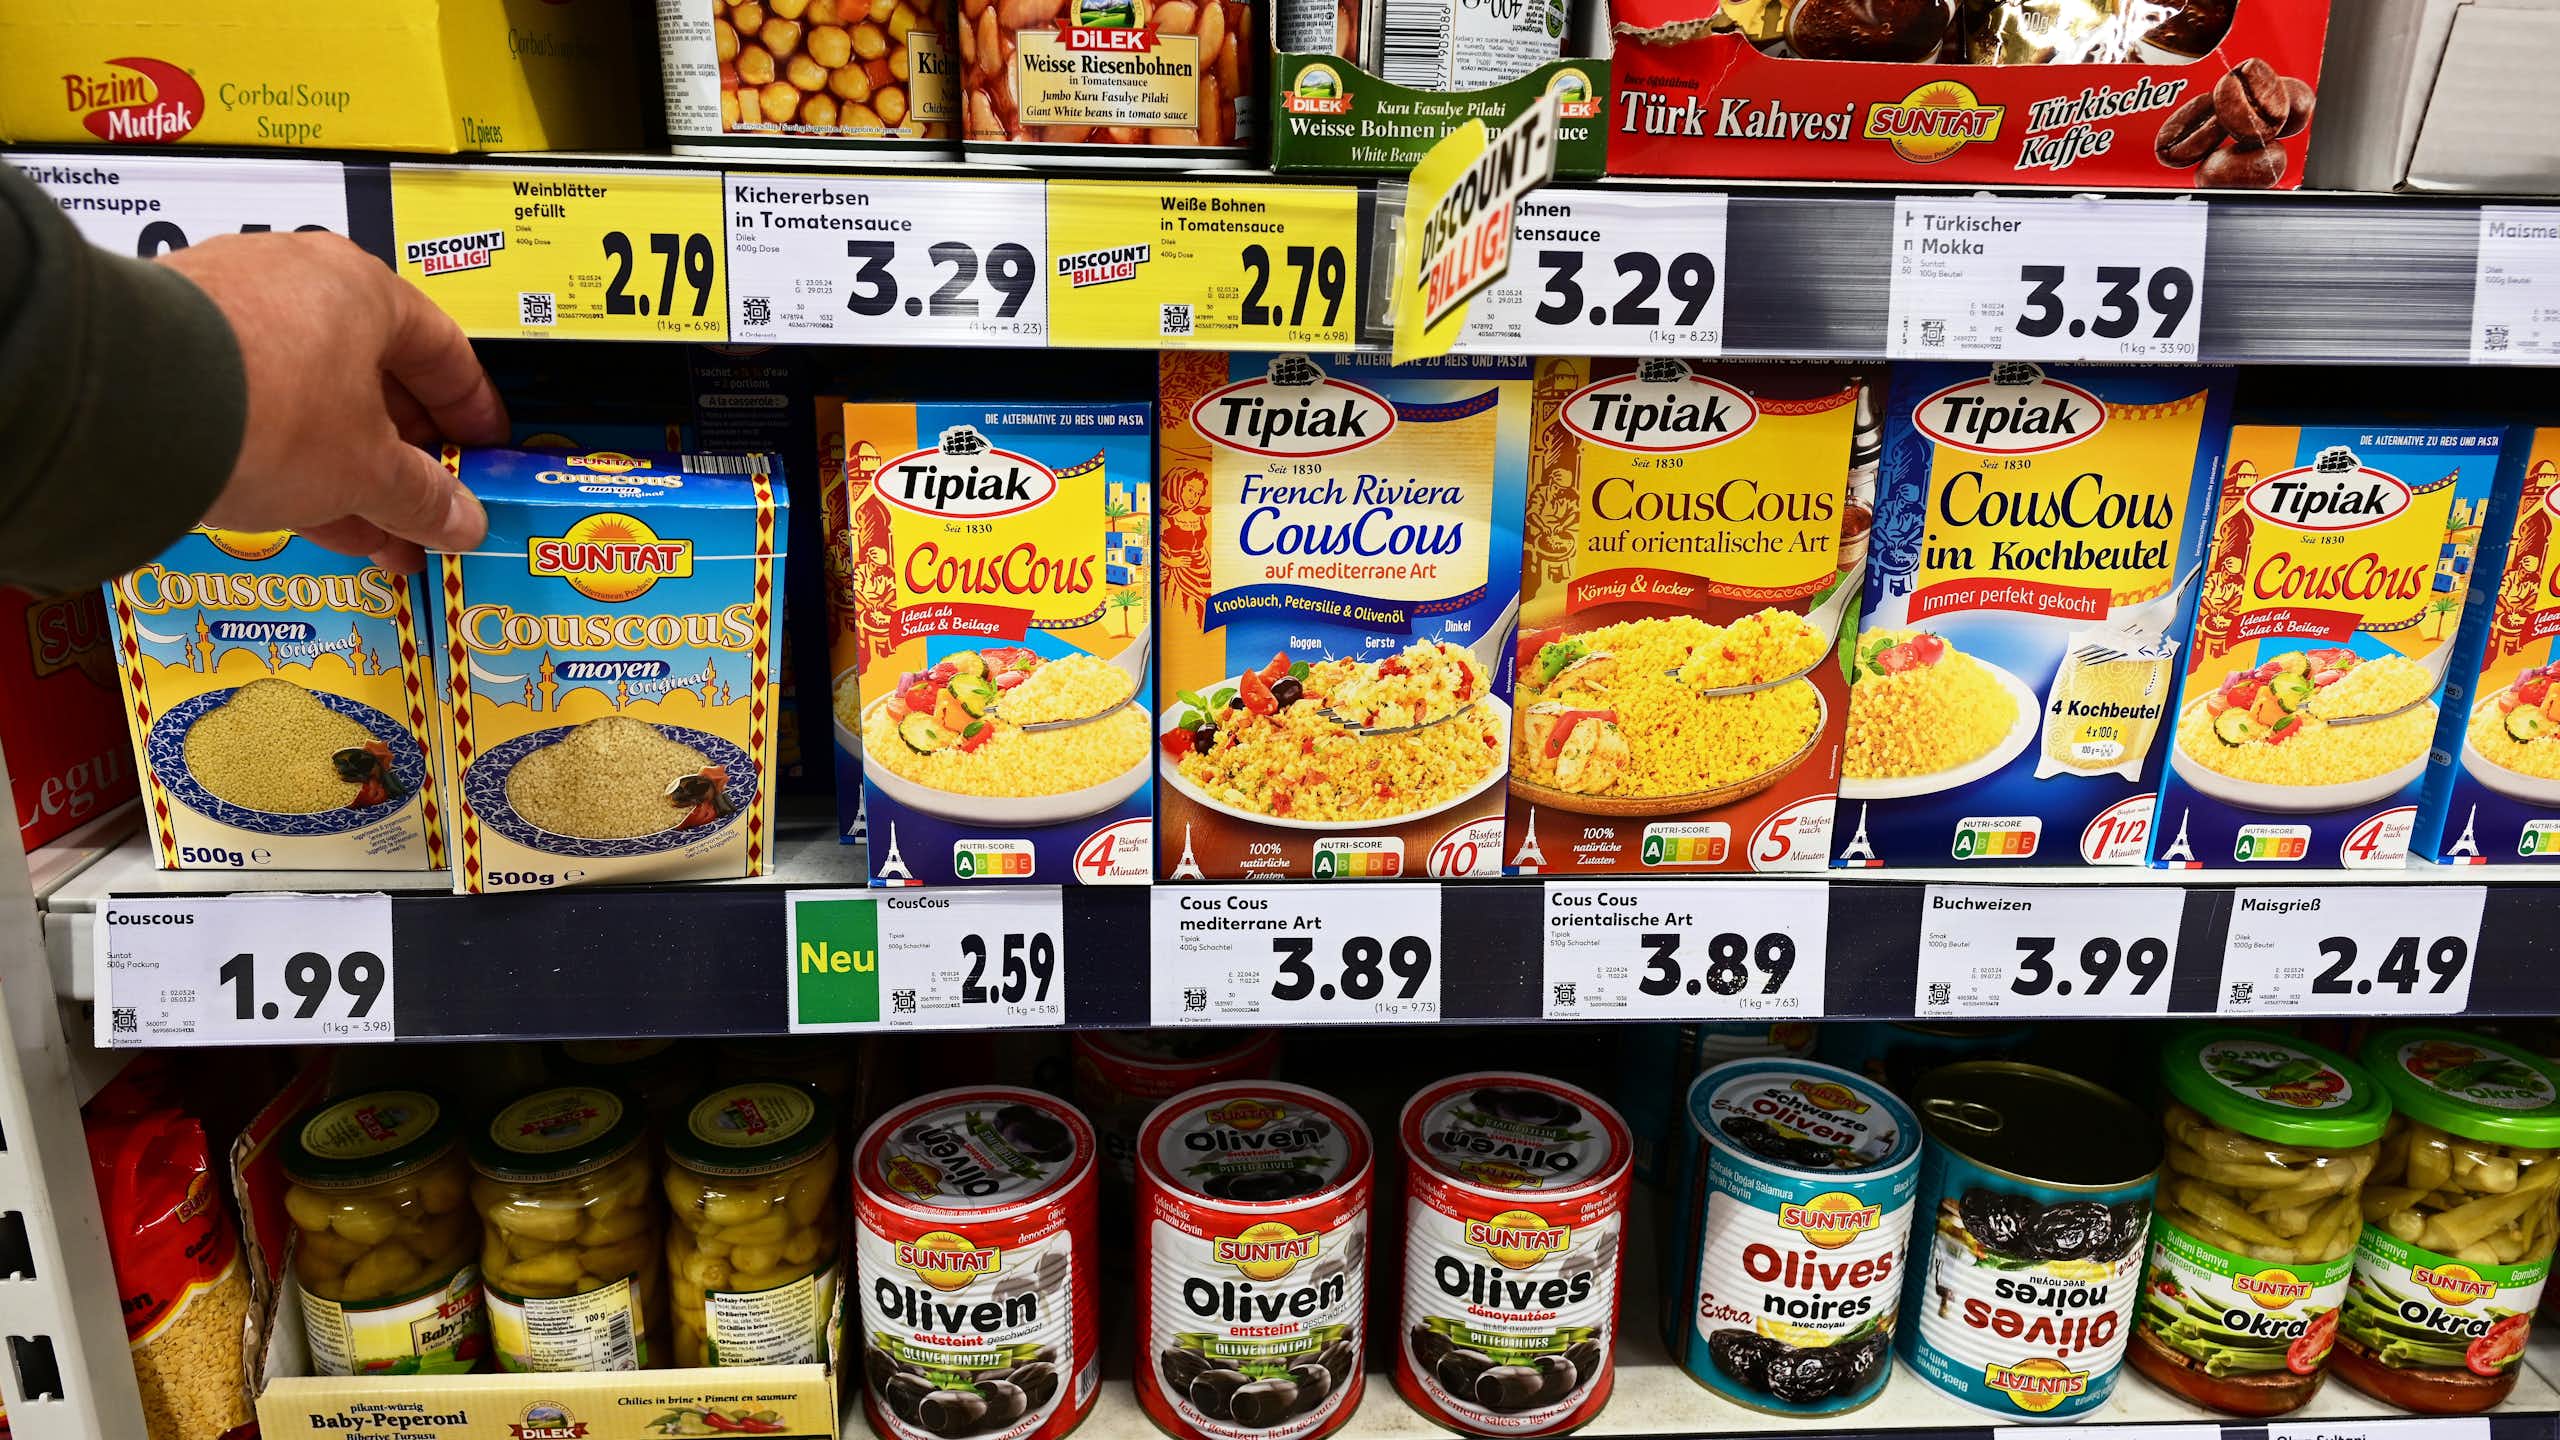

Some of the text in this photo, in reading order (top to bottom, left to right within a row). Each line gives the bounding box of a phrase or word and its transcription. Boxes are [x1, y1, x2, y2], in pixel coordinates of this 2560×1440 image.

[1024, 54, 1193, 77] Weisse Riesenbohnen
[62, 74, 147, 111] Bizim
[1041, 90, 1169, 104] Jumbo Kuru Fasulye Pilaki
[2029, 76, 2189, 134] Türkischer
[108, 103, 193, 140] Mutfak
[1027, 106, 1188, 120] Giant White beans in tomato sauce
[1377, 101, 1505, 117] Kuru Fasulye Pilaki
[1619, 90, 1856, 142] Türk Kahvesi
[1871, 106, 1998, 138] SUNTAT
[257, 116, 323, 144] Suppe
[463, 115, 502, 145] 12 pieces
[2014, 127, 2115, 170] Kaffee
[513, 181, 607, 199] Weinblätter
[735, 186, 869, 206] Kichererbsen
[514, 203, 566, 220] gefüllt
[1160, 197, 1265, 213] Weiße Bohnen
[736, 212, 912, 231] in Tomatensauce
[1160, 217, 1285, 234] in Tomatensauce
[1923, 214, 2022, 233] Türkischer
[407, 232, 501, 262] DISCOUNT
[1058, 245, 1147, 273] DISCOUNT
[1426, 201, 1511, 318] BILLIG!
[1922, 238, 1984, 256] Mokka
[423, 249, 488, 274] BILLIG!
[602, 231, 714, 317] 2.79
[1072, 263, 1133, 286] BILLIG!
[847, 240, 1036, 317] 3.29
[1241, 244, 1346, 327] 2.79
[1535, 250, 1715, 326] 3.29
[2015, 265, 2194, 339] 3.39
[985, 413, 1144, 426] DIE ALTERNATIVE ZU REIS UND PASTA
[1219, 397, 1368, 448] Tipiak
[1588, 394, 1731, 443] Tipiak
[1942, 397, 2081, 444] Tipiak
[898, 465, 1031, 509] Tipiak
[1240, 474, 1464, 505] French Riviera
[1592, 477, 1833, 522] CousCous
[1940, 471, 2173, 530] CousCous
[2270, 482, 2391, 522] Tipiak
[944, 522, 993, 534] Seit 1830
[1239, 507, 1464, 557] CousCous
[1588, 530, 1830, 554] auf orientalische Art
[1926, 536, 2170, 571] im Kochbeutel
[537, 544, 683, 573] SUNTAT
[905, 541, 1095, 594] CousCous
[1265, 561, 1437, 579] auf mediterrane Art
[1577, 574, 1695, 603] Körnig & locker
[2254, 552, 2428, 600] CousCous
[1214, 594, 1405, 624] Knoblauch, Petersilie & Olivenöl
[1923, 586, 2097, 614] Immer perfekt gekocht
[901, 606, 953, 623] Ideal als
[1445, 620, 1471, 631] Dinkel
[219, 622, 307, 642] moyen
[1291, 636, 1321, 649] Roggen
[1365, 636, 1395, 648] Gerste
[567, 660, 660, 681] moyen
[1583, 828, 1615, 839] 100%
[1650, 826, 1711, 834] NUTRI-SCORE
[1760, 816, 1798, 863] 5
[183, 847, 244, 866] 500g
[1082, 834, 1115, 877] 4
[1249, 843, 1281, 855] 100%
[1320, 841, 1383, 849] NUTRI-SCORE
[1573, 842, 1622, 854] natürliche
[1791, 851, 1825, 863] Minuten
[2108, 848, 2141, 860] Minuten
[1110, 865, 1149, 877] Minuten
[1438, 841, 1478, 877] 10
[1577, 855, 1616, 865] Zutaten
[487, 872, 555, 887] 500g
[887, 897, 950, 911] CousCous
[1180, 897, 1268, 911] Cous Cous
[1552, 893, 1638, 907] Cous Cous
[1932, 896, 2032, 911] Buchweizen
[2240, 898, 2321, 913] Maisgrieß
[106, 911, 194, 926] Couscous
[1180, 916, 1322, 931] mediterrane Art
[1552, 912, 1693, 927] orientalische Art
[126, 960, 160, 970] Packung
[801, 942, 875, 974] Neu
[960, 933, 1055, 1004] 2.59
[1271, 935, 1432, 1001] 3.89
[1639, 932, 1796, 996] 3.89
[2010, 937, 2168, 996] 3.99
[2311, 936, 2468, 995] 2.49
[220, 951, 386, 1020] 1.99
[1386, 1002, 1399, 1015] kg
[1412, 1002, 1436, 1014] 9.73)
[1763, 1088, 1868, 1133] Schwarze
[1784, 1207, 1877, 1230] SUNTAT
[1218, 1239, 1314, 1261] SUNTAT
[1471, 1225, 1565, 1250] SUNTAT
[899, 1246, 993, 1272] SUNTAT
[1743, 1243, 1893, 1291] Olives
[1435, 1255, 1591, 1310] Olives
[2238, 1277, 2310, 1296] SUNTAT
[2416, 1269, 2493, 1295] SUNTAT
[876, 1277, 1038, 1334] Oliven
[1183, 1274, 1344, 1323] Oliven
[1700, 1293, 1753, 1324] Extra
[1763, 1293, 1872, 1320] noires
[1995, 1278, 2107, 1316] noires
[1230, 1322, 1299, 1337] entsteint
[2223, 1309, 2308, 1337] Okra
[2400, 1301, 2491, 1336] Okra
[914, 1333, 984, 1347] entsteint
[310, 1411, 468, 1431] Baby-Peperoni
[350, 1403, 424, 1413] pikant-würzig
